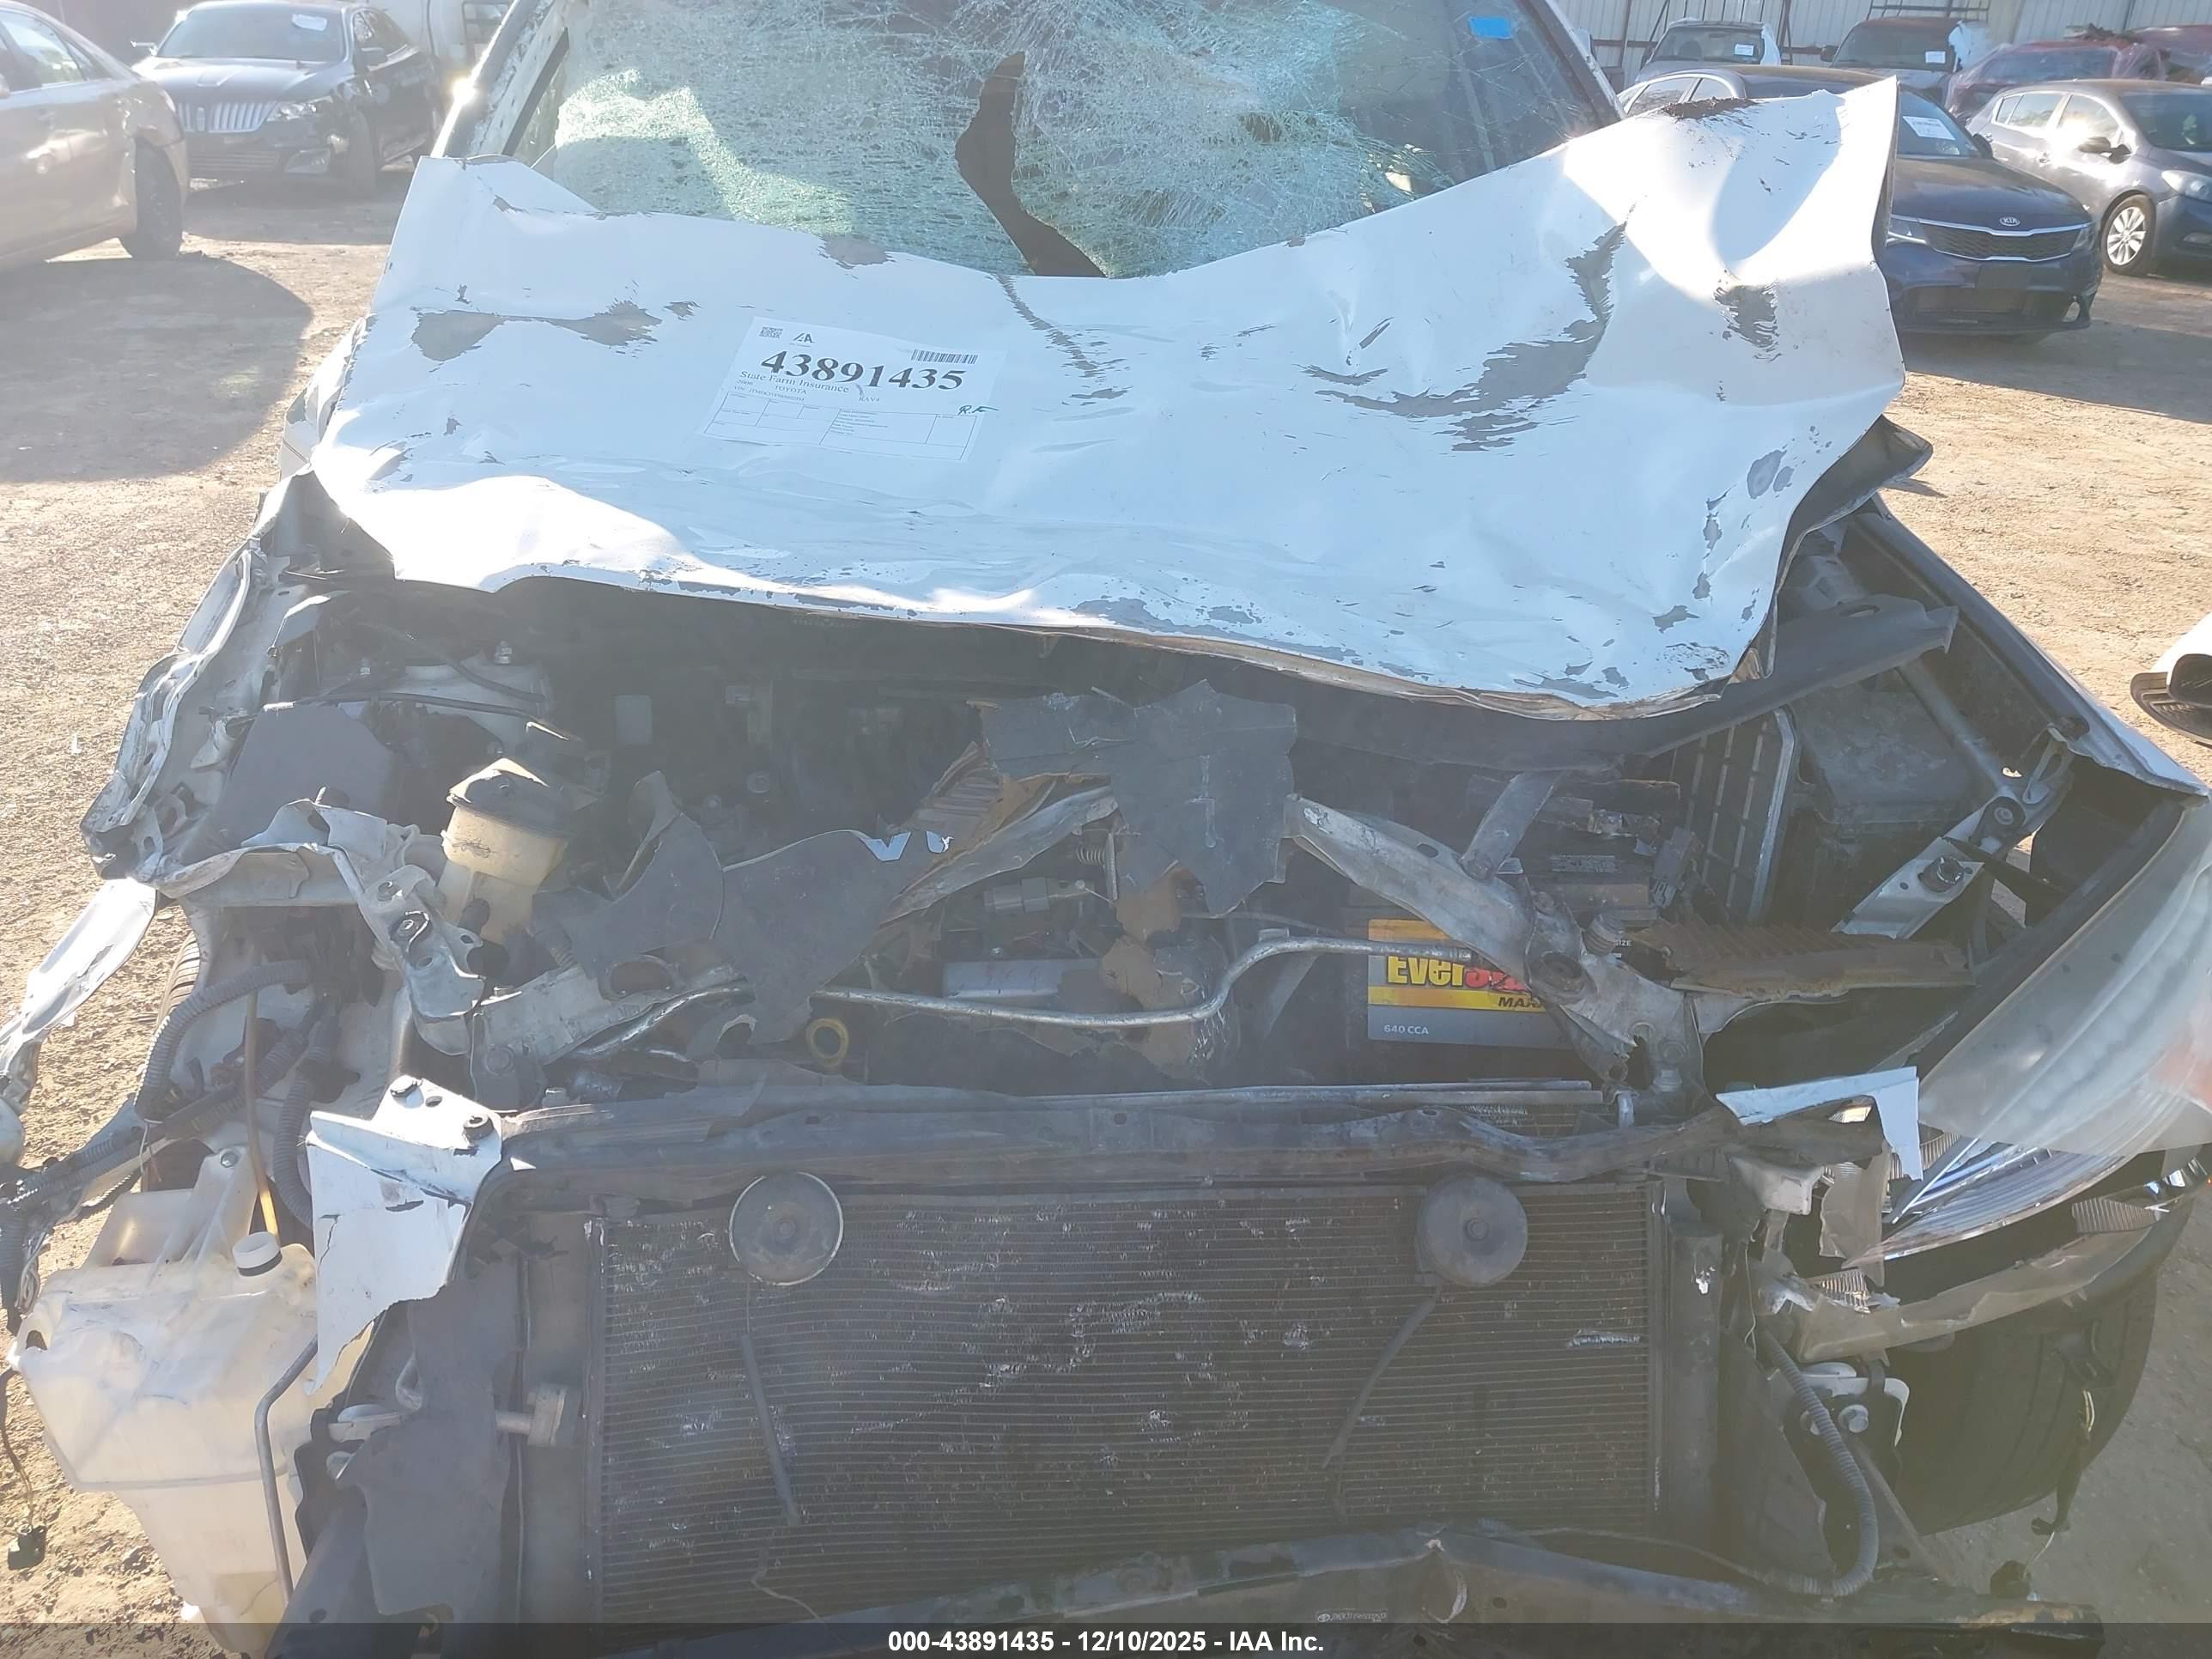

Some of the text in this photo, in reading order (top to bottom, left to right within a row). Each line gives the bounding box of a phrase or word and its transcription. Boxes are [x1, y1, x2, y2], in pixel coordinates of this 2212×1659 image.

[761, 350, 967, 390] 43891435
[739, 371, 849, 393] State Farm Insurance
[775, 386, 807, 395] TOYOTA
[1383, 1024, 1429, 1035] 640 CCA
